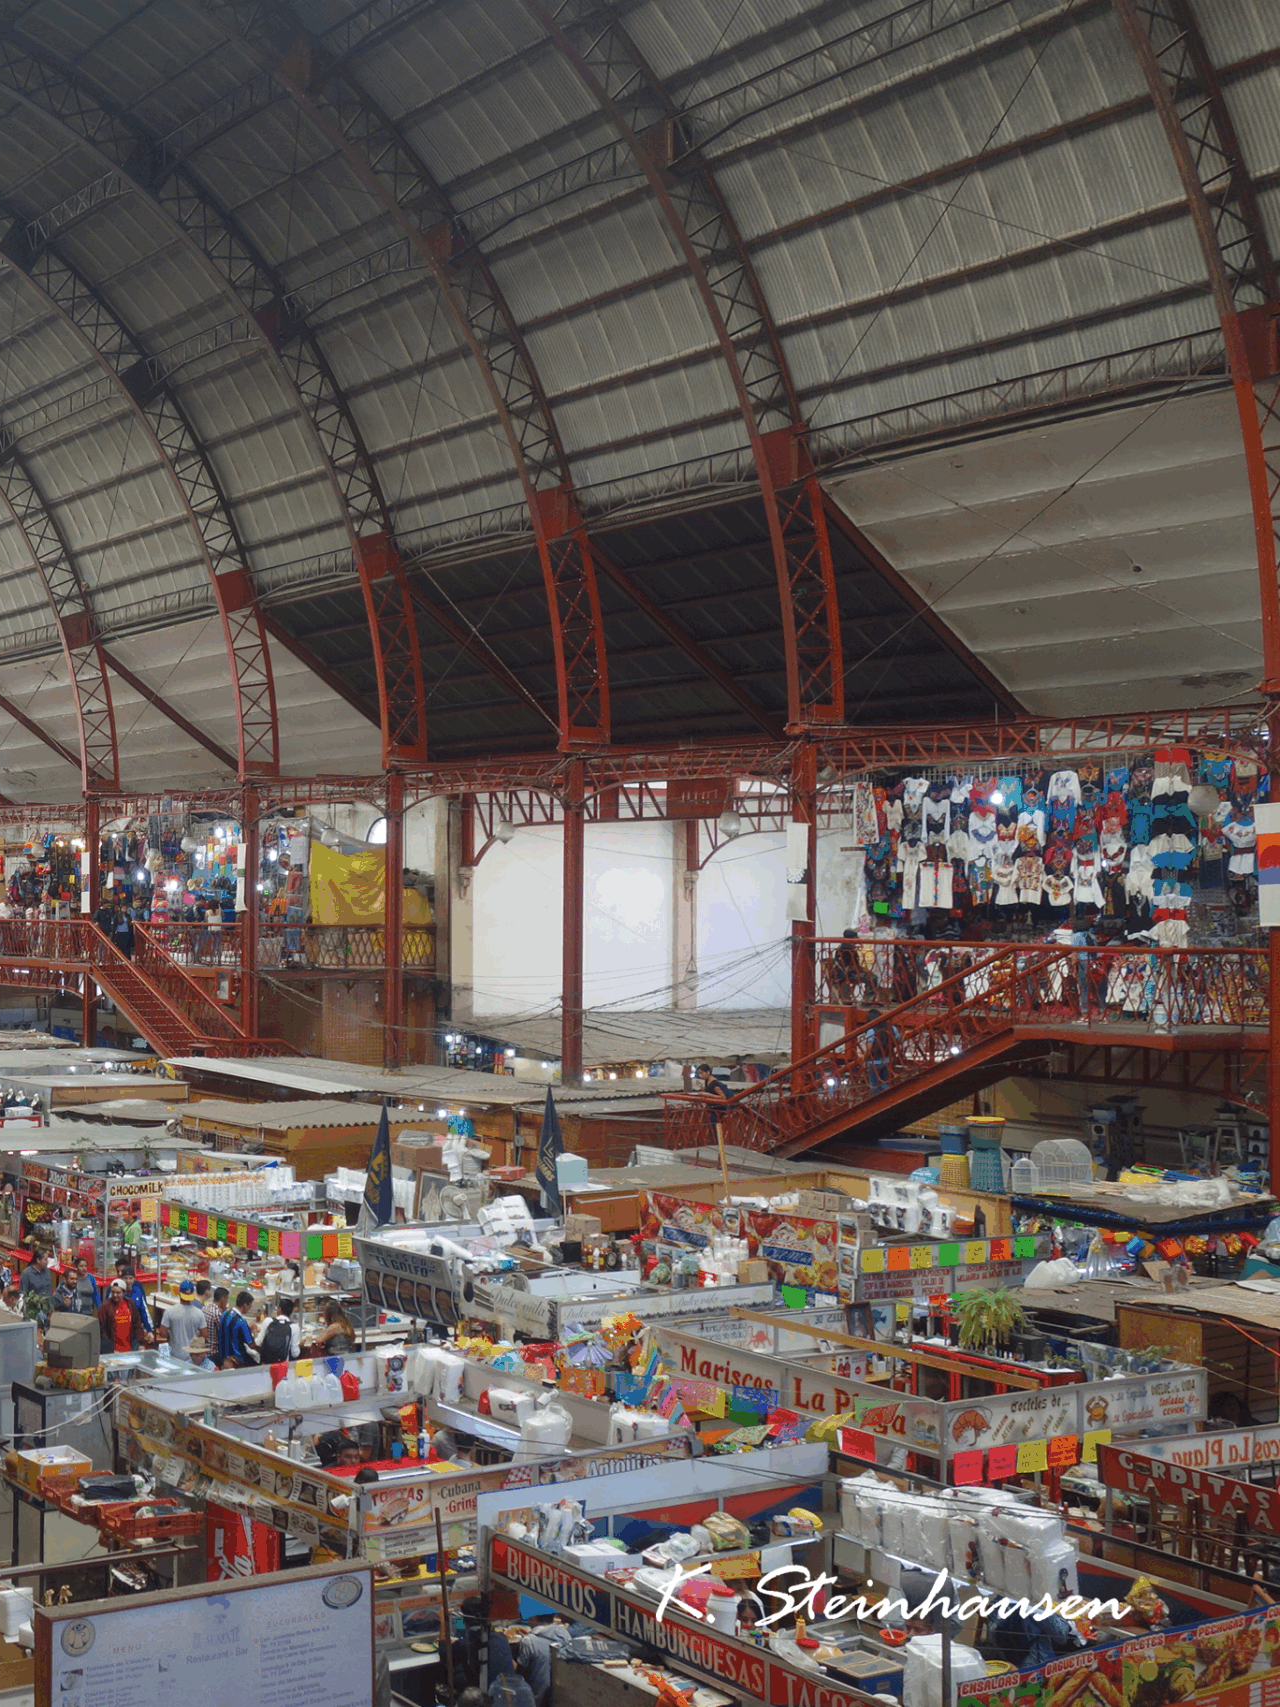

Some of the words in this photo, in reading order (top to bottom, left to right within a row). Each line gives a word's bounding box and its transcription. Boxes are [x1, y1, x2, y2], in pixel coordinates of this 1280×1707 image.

[680, 1345, 773, 1391] Mariscos
[793, 1377, 826, 1412] La
[448, 1496, 477, 1513] Gring
[1126, 1472, 1161, 1498] LA
[1180, 1487, 1274, 1530] PLAA
[506, 1547, 597, 1620] BURRITOS
[620, 1602, 766, 1695] HAMBURGUESAS
[1198, 1616, 1245, 1638] PECHUGAS
[186, 1651, 229, 1665] Restaurant
[235, 1647, 249, 1656] Bar
